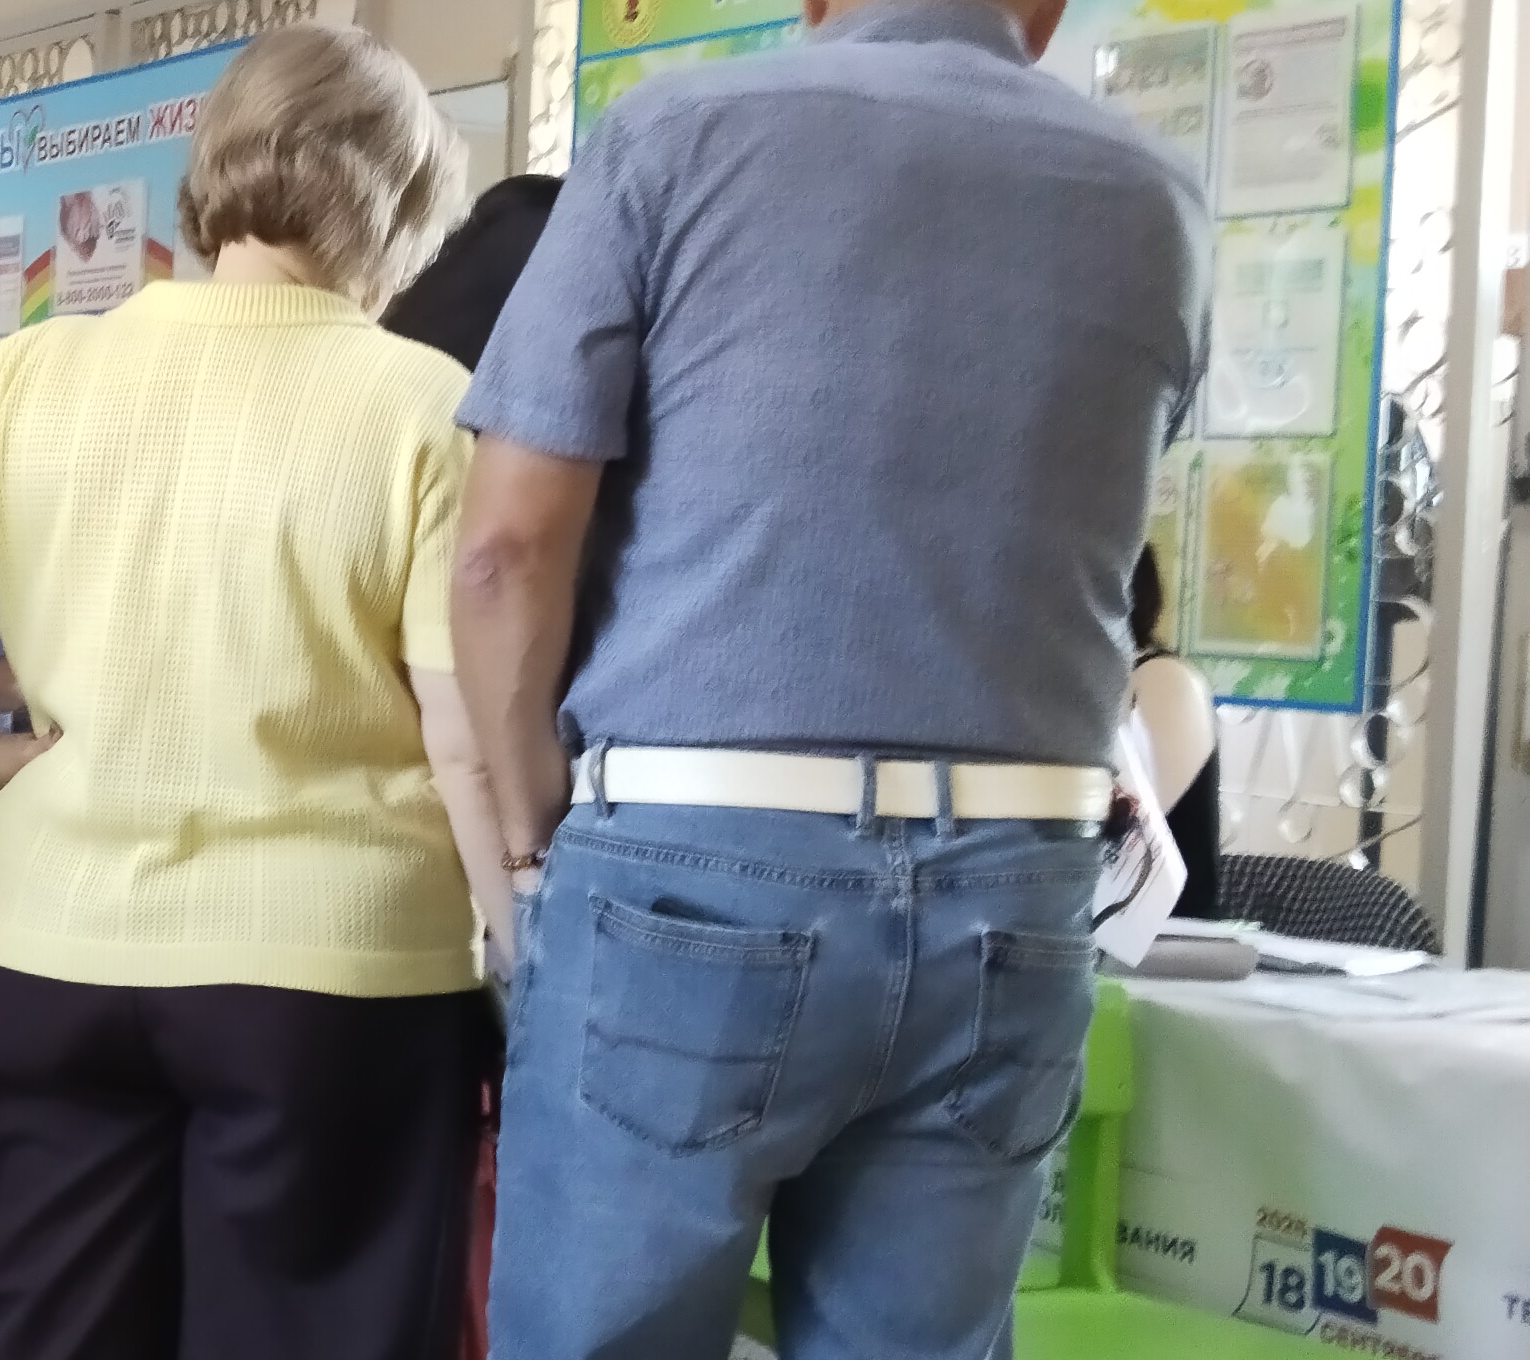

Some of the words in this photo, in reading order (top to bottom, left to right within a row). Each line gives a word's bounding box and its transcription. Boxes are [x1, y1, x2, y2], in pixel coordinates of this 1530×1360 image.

[36, 115, 141, 162] ВЫБИРАЕМ
[150, 97, 200, 140] ЖИЗ
[1116, 1217, 1197, 1266] ВАНИЯ
[1259, 1259, 1306, 1313] 18
[1318, 1249, 1364, 1304] 19
[1373, 1242, 1436, 1302] 20
